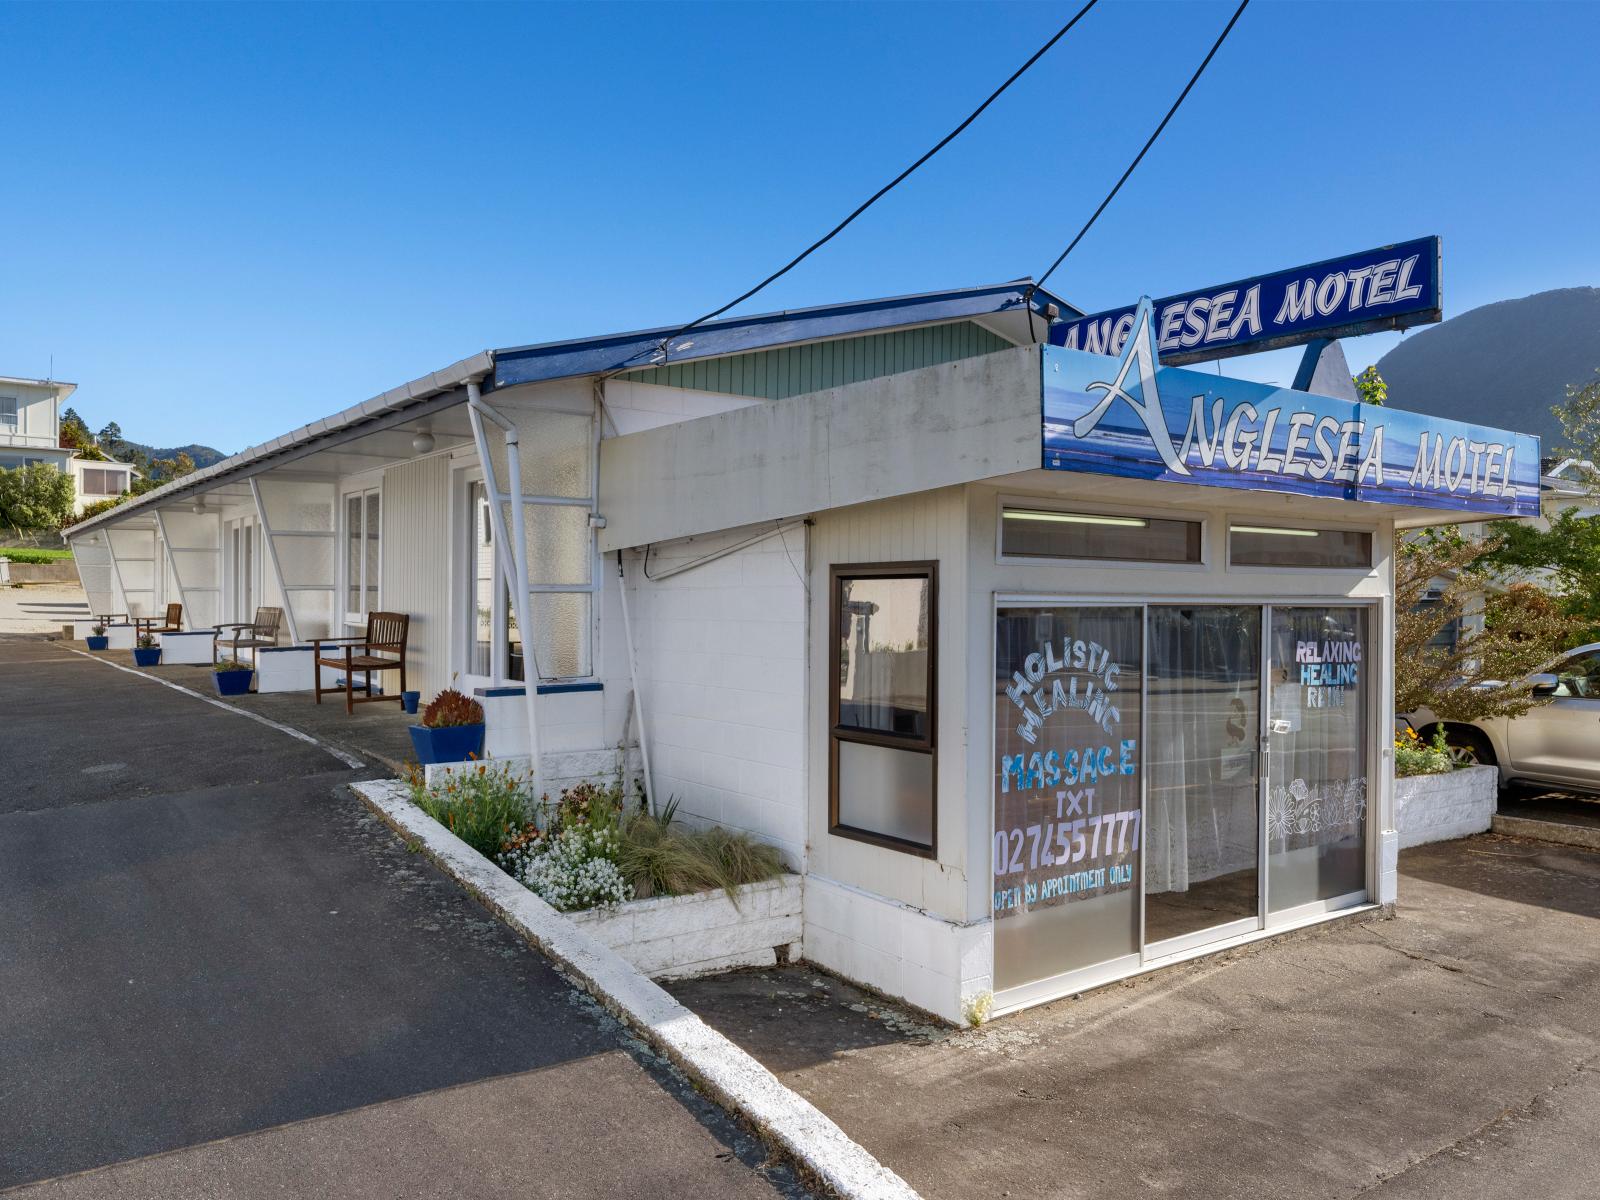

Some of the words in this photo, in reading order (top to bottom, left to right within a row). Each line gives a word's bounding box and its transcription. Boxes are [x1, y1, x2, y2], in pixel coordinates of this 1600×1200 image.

[1063, 283, 1263, 357] ANGESEA
[1273, 254, 1423, 325] MOTEL
[1073, 300, 1385, 487] ANGLESEA
[1408, 431, 1517, 499] MOTEL
[1005, 636, 1121, 709] HOLISTIC
[1296, 641, 1362, 663] RELAXING
[1300, 663, 1358, 686] HEALING
[1016, 676, 1121, 745] HEALING
[1001, 739, 1137, 793] MASSAGE
[1055, 788, 1096, 819] TXT
[994, 809, 1142, 876] 0274557777
[994, 886, 1021, 911] OPEN
[1024, 881, 1038, 905] BY
[1041, 867, 1106, 900] APPOINTMENT
[1109, 863, 1133, 885] ONLY
